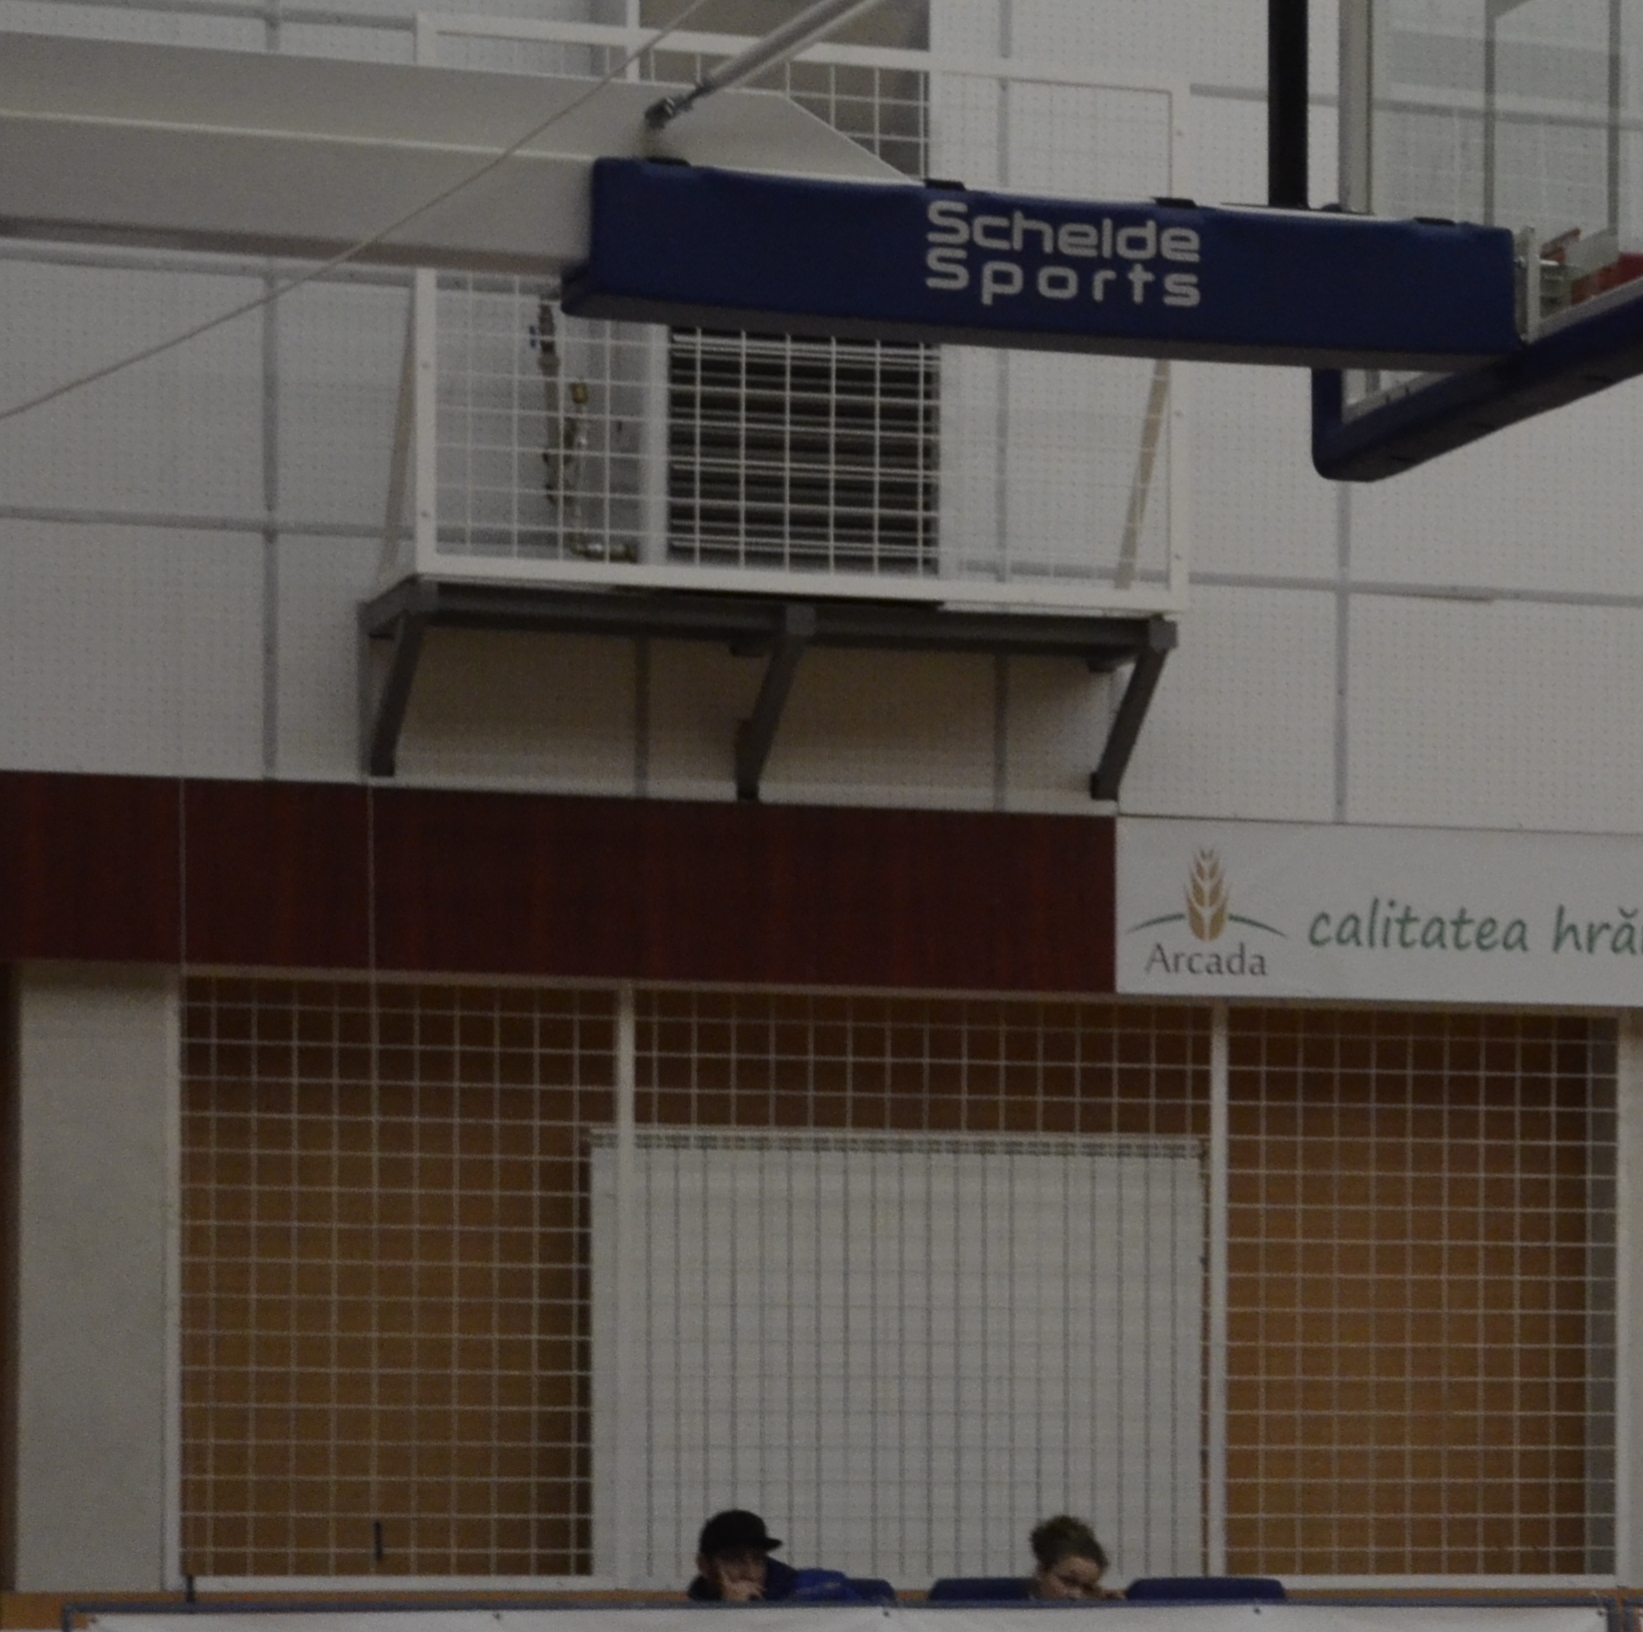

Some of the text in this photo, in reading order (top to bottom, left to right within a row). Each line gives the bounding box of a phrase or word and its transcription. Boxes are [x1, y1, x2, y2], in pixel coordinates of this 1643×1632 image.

[927, 200, 1201, 263] Schelde
[925, 247, 1201, 307] Sports
[1308, 898, 1531, 952] calitatea
[1143, 942, 1268, 979] Arcada
